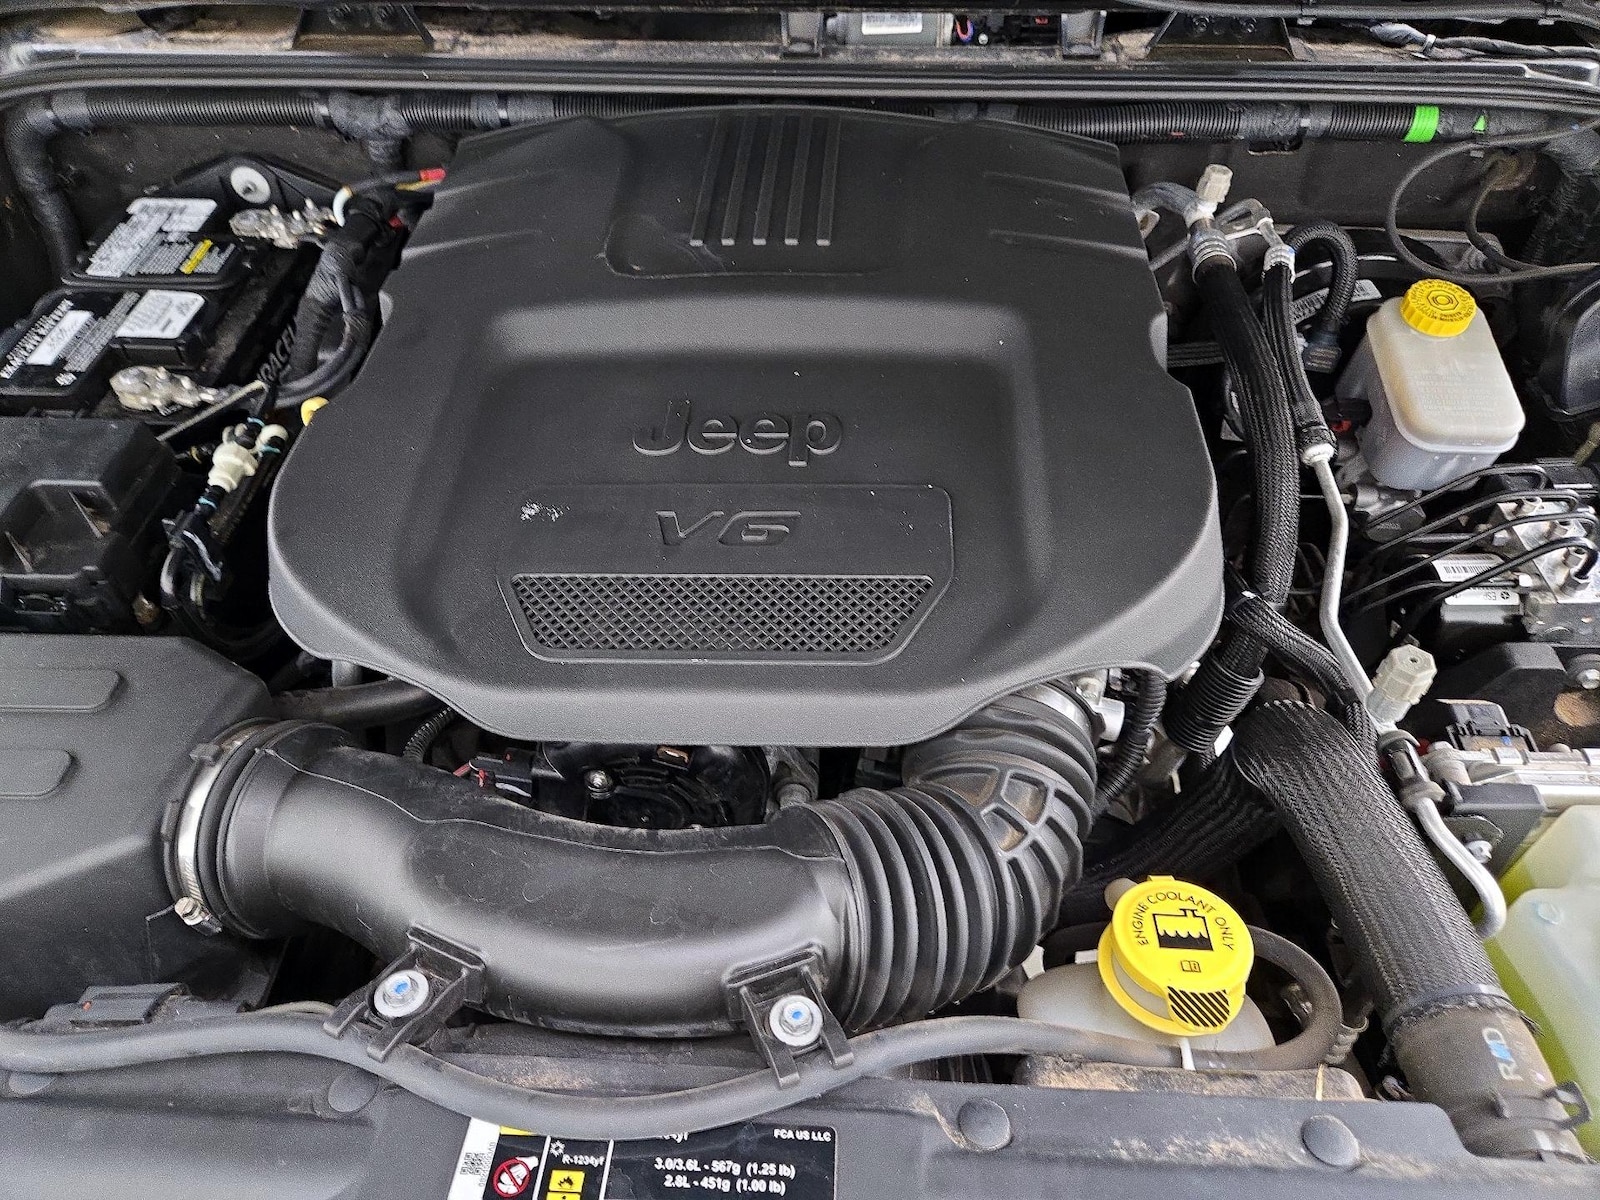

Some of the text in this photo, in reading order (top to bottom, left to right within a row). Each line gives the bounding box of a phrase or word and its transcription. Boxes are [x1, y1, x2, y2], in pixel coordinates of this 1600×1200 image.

[632, 398, 843, 467] Jeep
[655, 510, 802, 547] V6
[1132, 891, 1236, 951] ENGINE COOLANT ONLY
[773, 1128, 832, 1143] FCA US LLC
[654, 1156, 702, 1172] 3.0/3.6L
[711, 1159, 741, 1176] 567g
[746, 1161, 777, 1177] (1.25
[778, 1163, 796, 1180] lb)
[663, 1174, 691, 1189] 2.8L
[700, 1175, 731, 1192] 451g
[735, 1177, 767, 1194] (1.00
[768, 1180, 786, 1197] lb)
